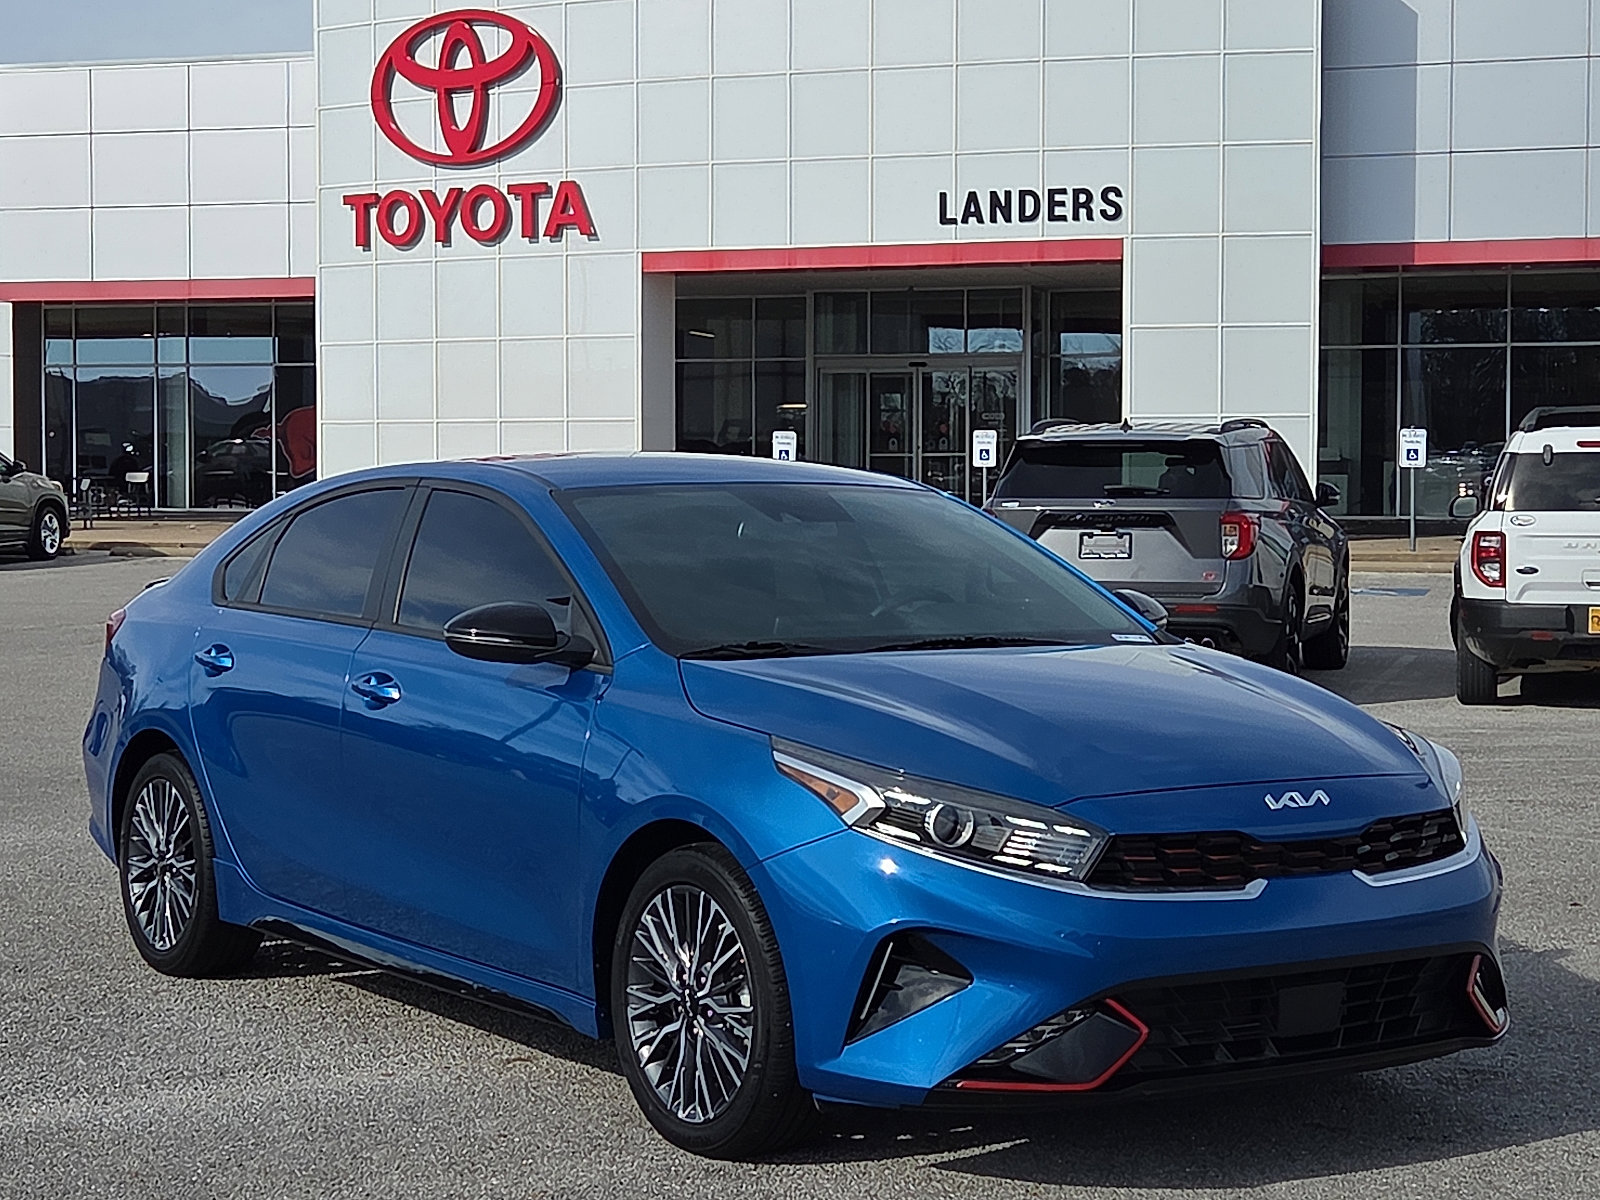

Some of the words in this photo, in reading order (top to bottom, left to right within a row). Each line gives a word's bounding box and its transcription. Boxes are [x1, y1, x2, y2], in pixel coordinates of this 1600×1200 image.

[343, 180, 598, 250] TOYOTA
[938, 186, 1123, 225] LANDERS
[1264, 789, 1331, 810] KIA
